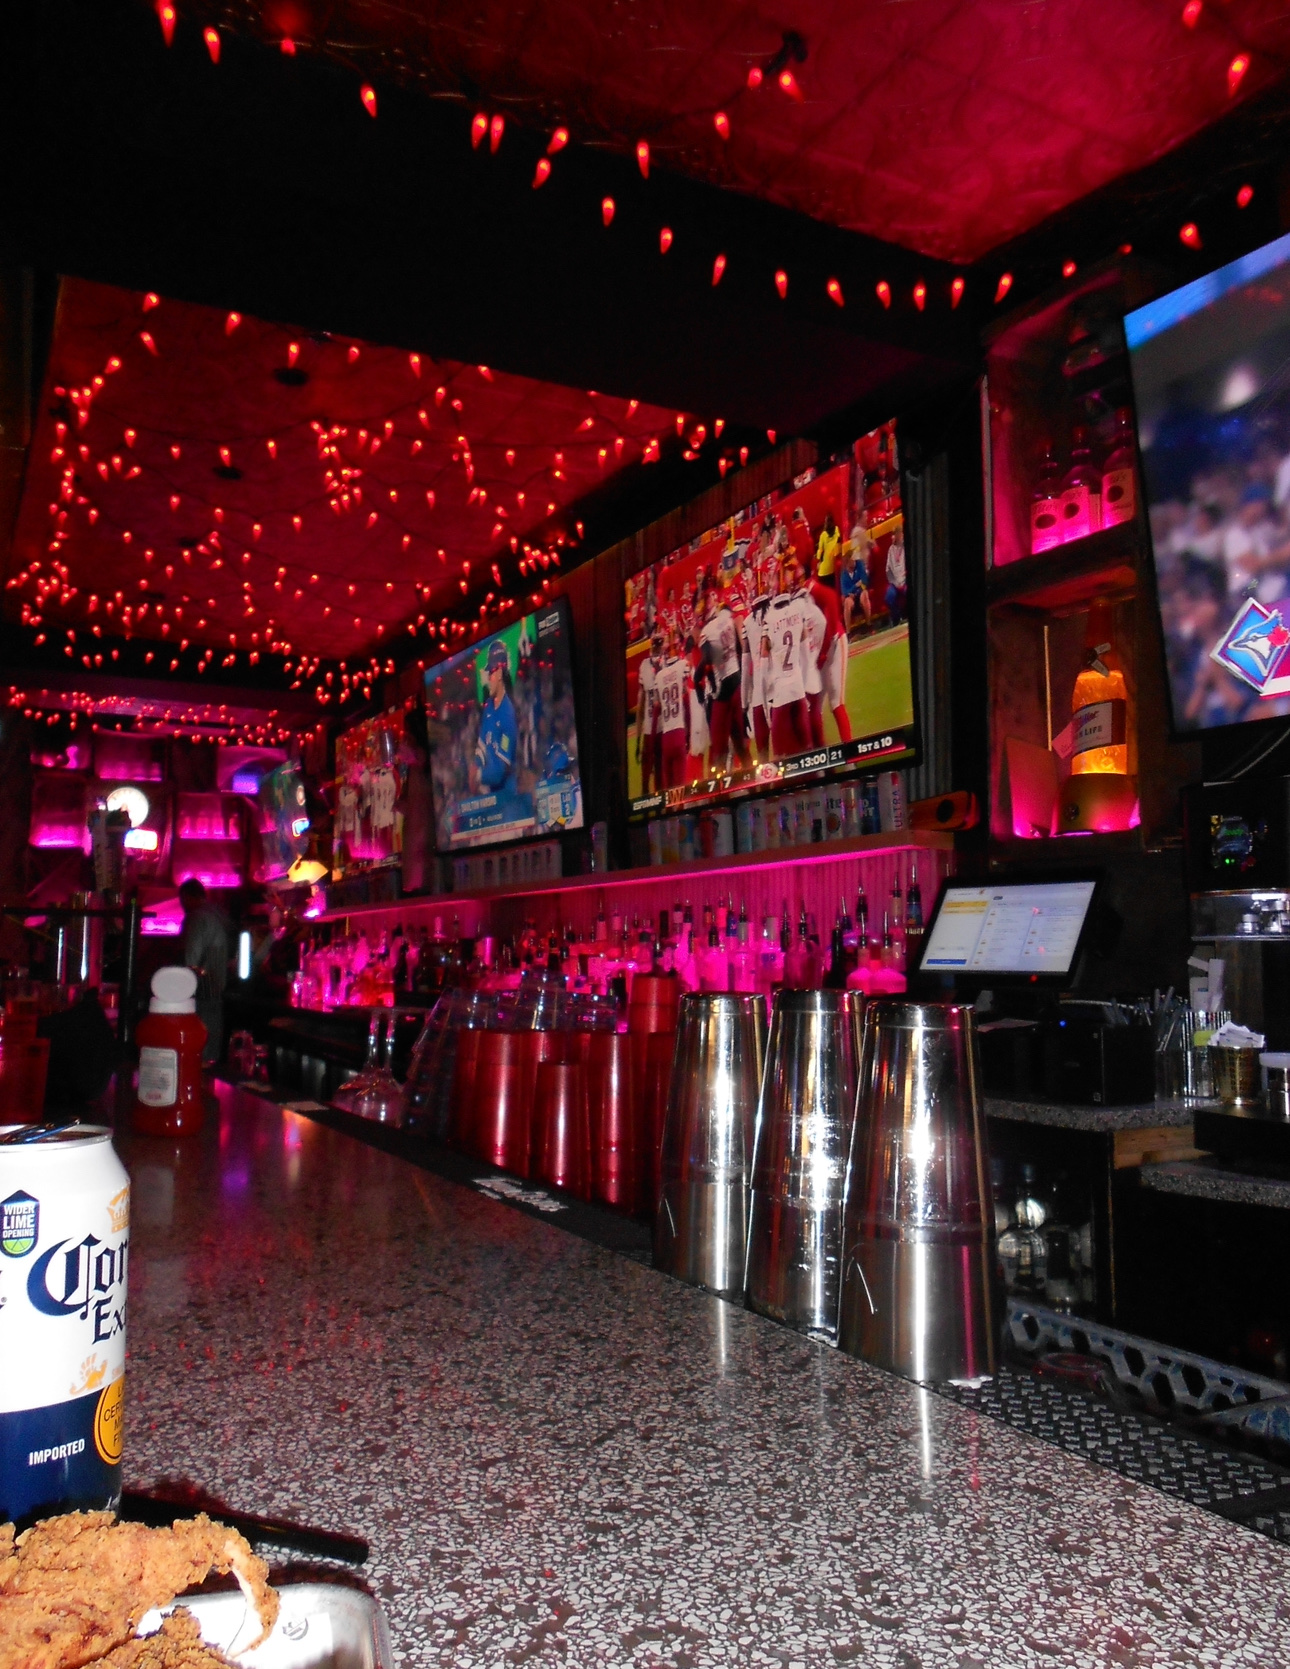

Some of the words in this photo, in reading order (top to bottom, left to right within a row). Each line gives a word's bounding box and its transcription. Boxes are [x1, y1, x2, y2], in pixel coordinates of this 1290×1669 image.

[782, 630, 793, 671] 2
[661, 683, 680, 723] 39
[1084, 726, 1102, 736] LIFE
[857, 743, 873, 754] 1ST
[880, 736, 893, 748] 10
[799, 753, 827, 769] 13:00
[830, 750, 843, 761] 21
[707, 780, 716, 792] 7
[723, 777, 732, 788] 7
[826, 798, 842, 810] ite
[891, 789, 904, 828] ULTRA
[4, 1203, 35, 1215] WIDER
[3, 1214, 35, 1229] LIME
[3, 1228, 35, 1239] OPENING
[29, 1438, 85, 1465] IMPORTED
